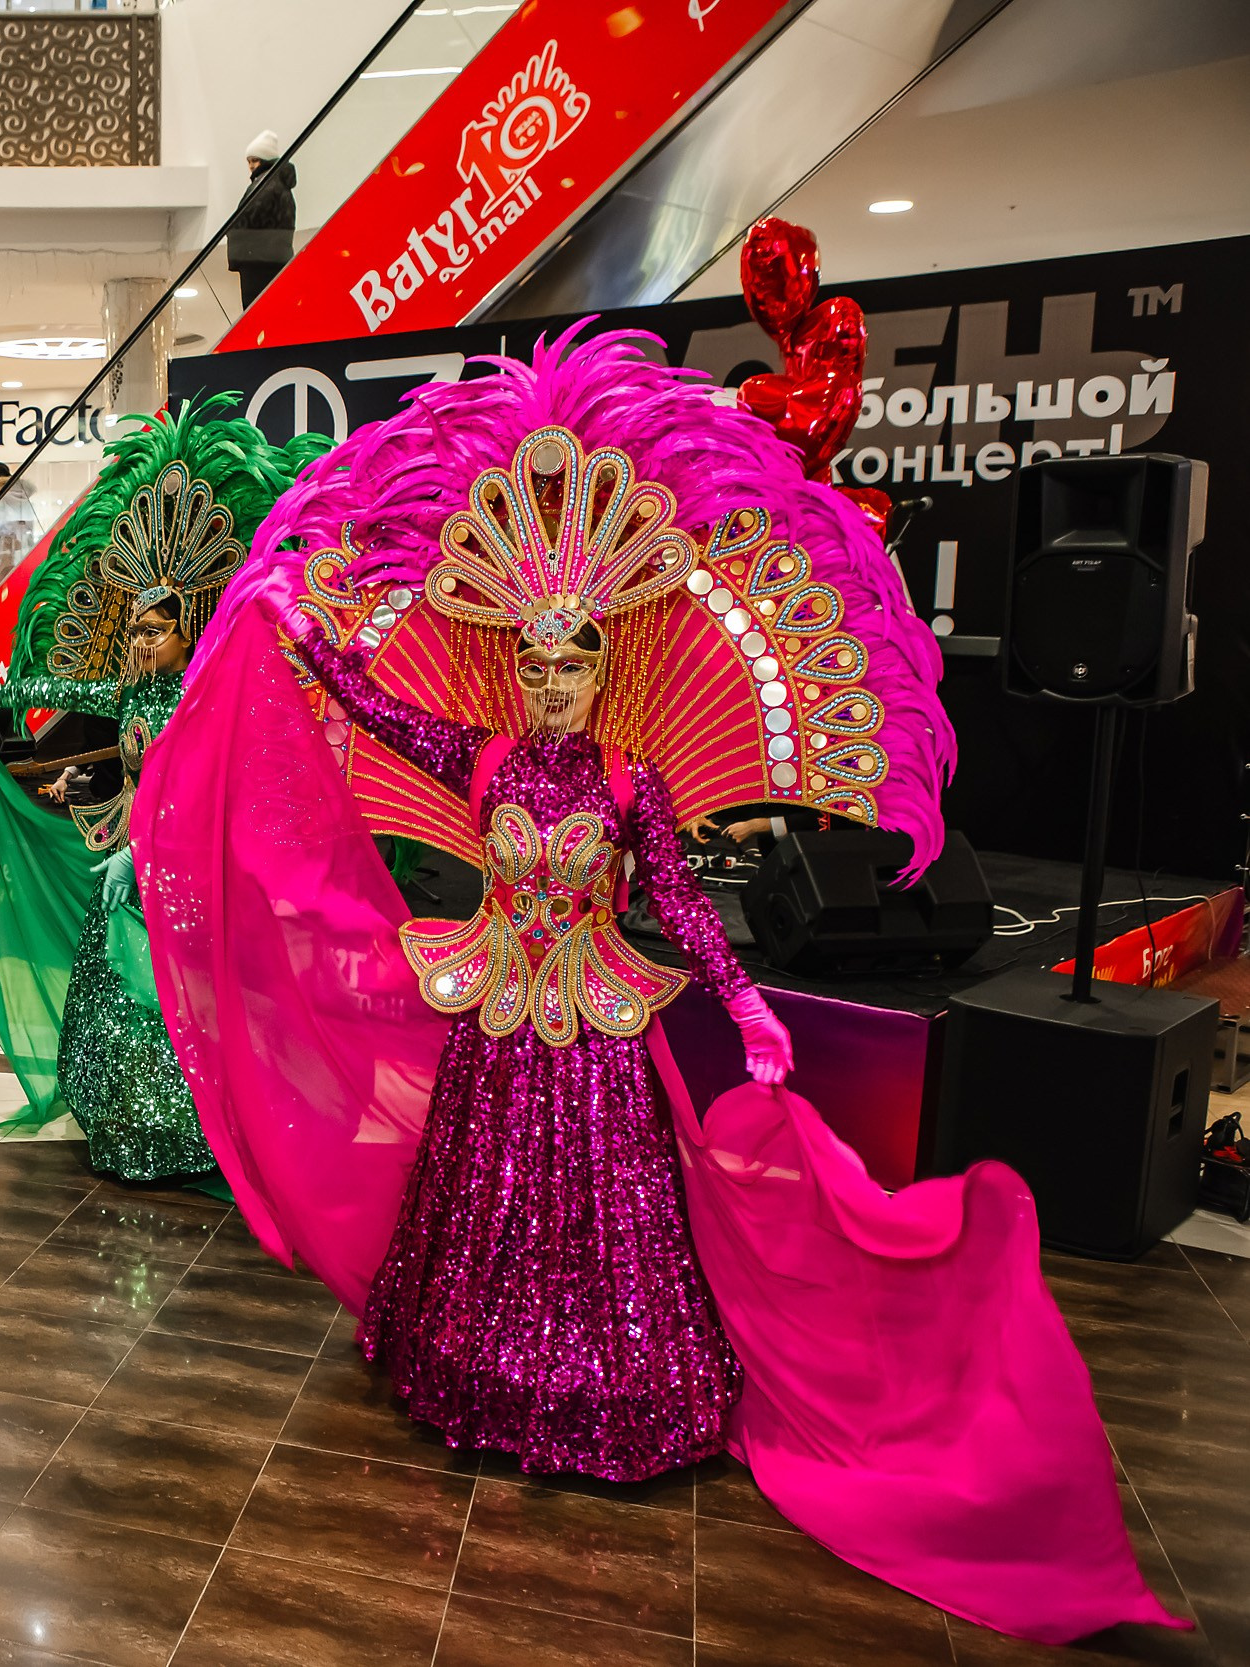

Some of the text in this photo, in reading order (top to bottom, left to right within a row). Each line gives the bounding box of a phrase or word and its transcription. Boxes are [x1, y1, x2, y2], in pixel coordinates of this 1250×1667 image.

[472, 176, 542, 254] mall
[350, 187, 478, 332] Batyr
[854, 357, 1176, 430] большой
